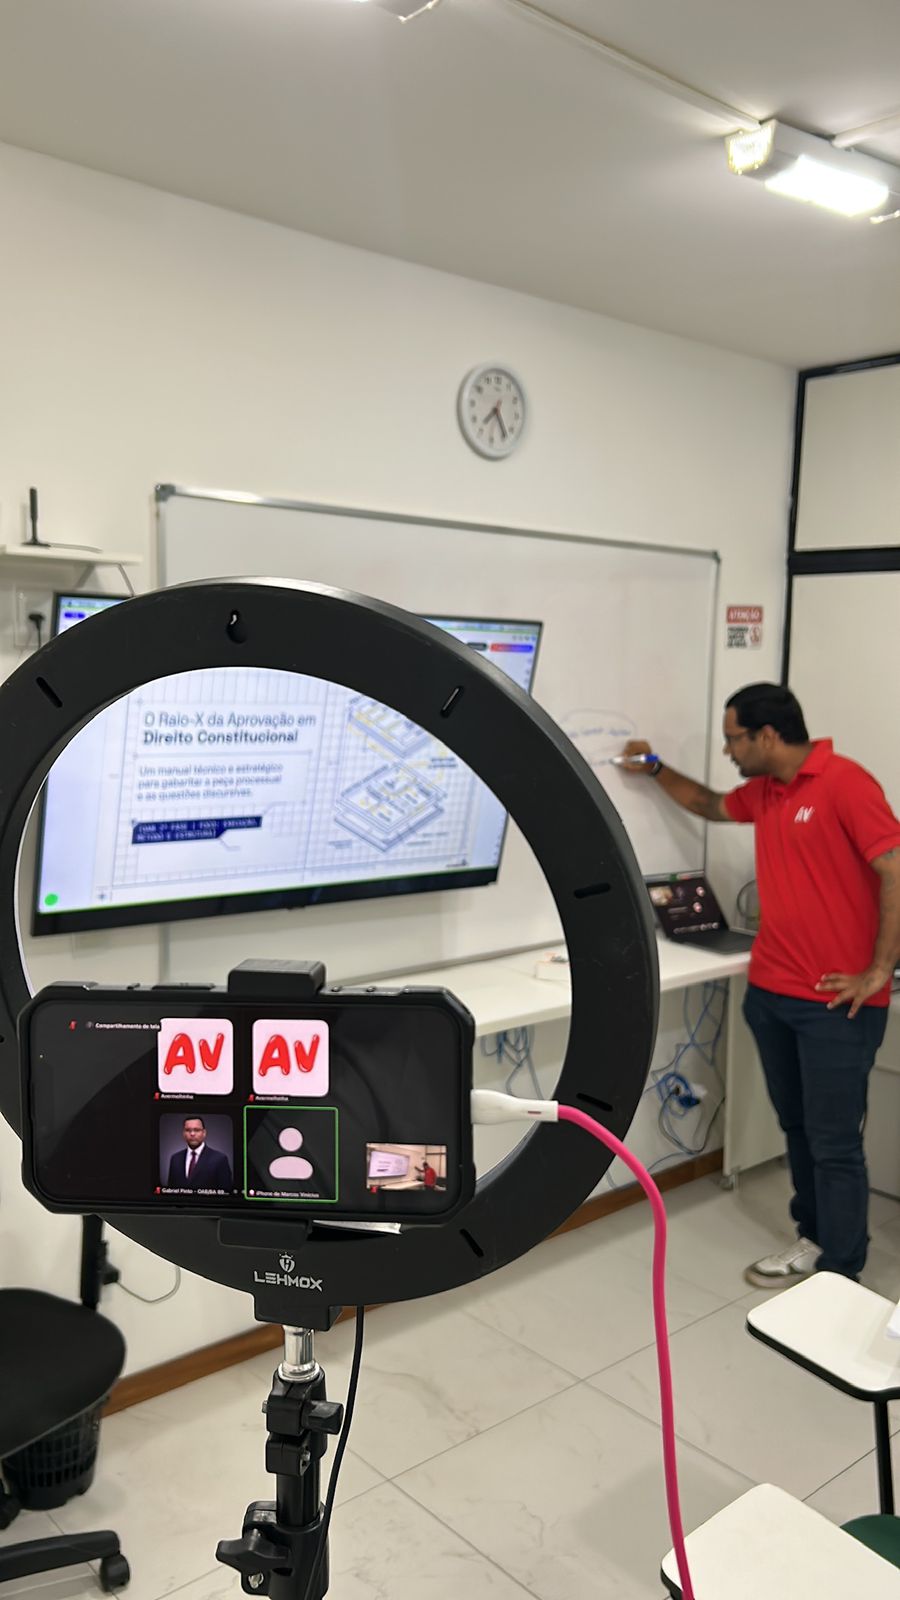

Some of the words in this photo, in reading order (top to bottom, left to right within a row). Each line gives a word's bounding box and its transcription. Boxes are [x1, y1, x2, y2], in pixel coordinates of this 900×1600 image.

[144, 711, 155, 727] O
[159, 711, 204, 727] Raio-X
[207, 711, 224, 727] da
[227, 711, 295, 729] Aprovação
[298, 714, 316, 726] em
[143, 730, 193, 745] Direito
[197, 729, 299, 744] Constitucional
[139, 766, 156, 777] Um
[158, 765, 192, 775] manual
[193, 764, 225, 775] técnico
[236, 763, 283, 776] estratégico
[138, 779, 160, 791] para
[161, 776, 203, 789] gabaritar
[212, 777, 234, 788] peça
[235, 775, 282, 787] processual
[158, 789, 201, 802] questões
[95, 1022, 142, 1030] Compartilhamento
[163, 1032, 224, 1075] AV
[258, 1034, 320, 1077] AV
[254, 1270, 323, 1292] LEHMOX
